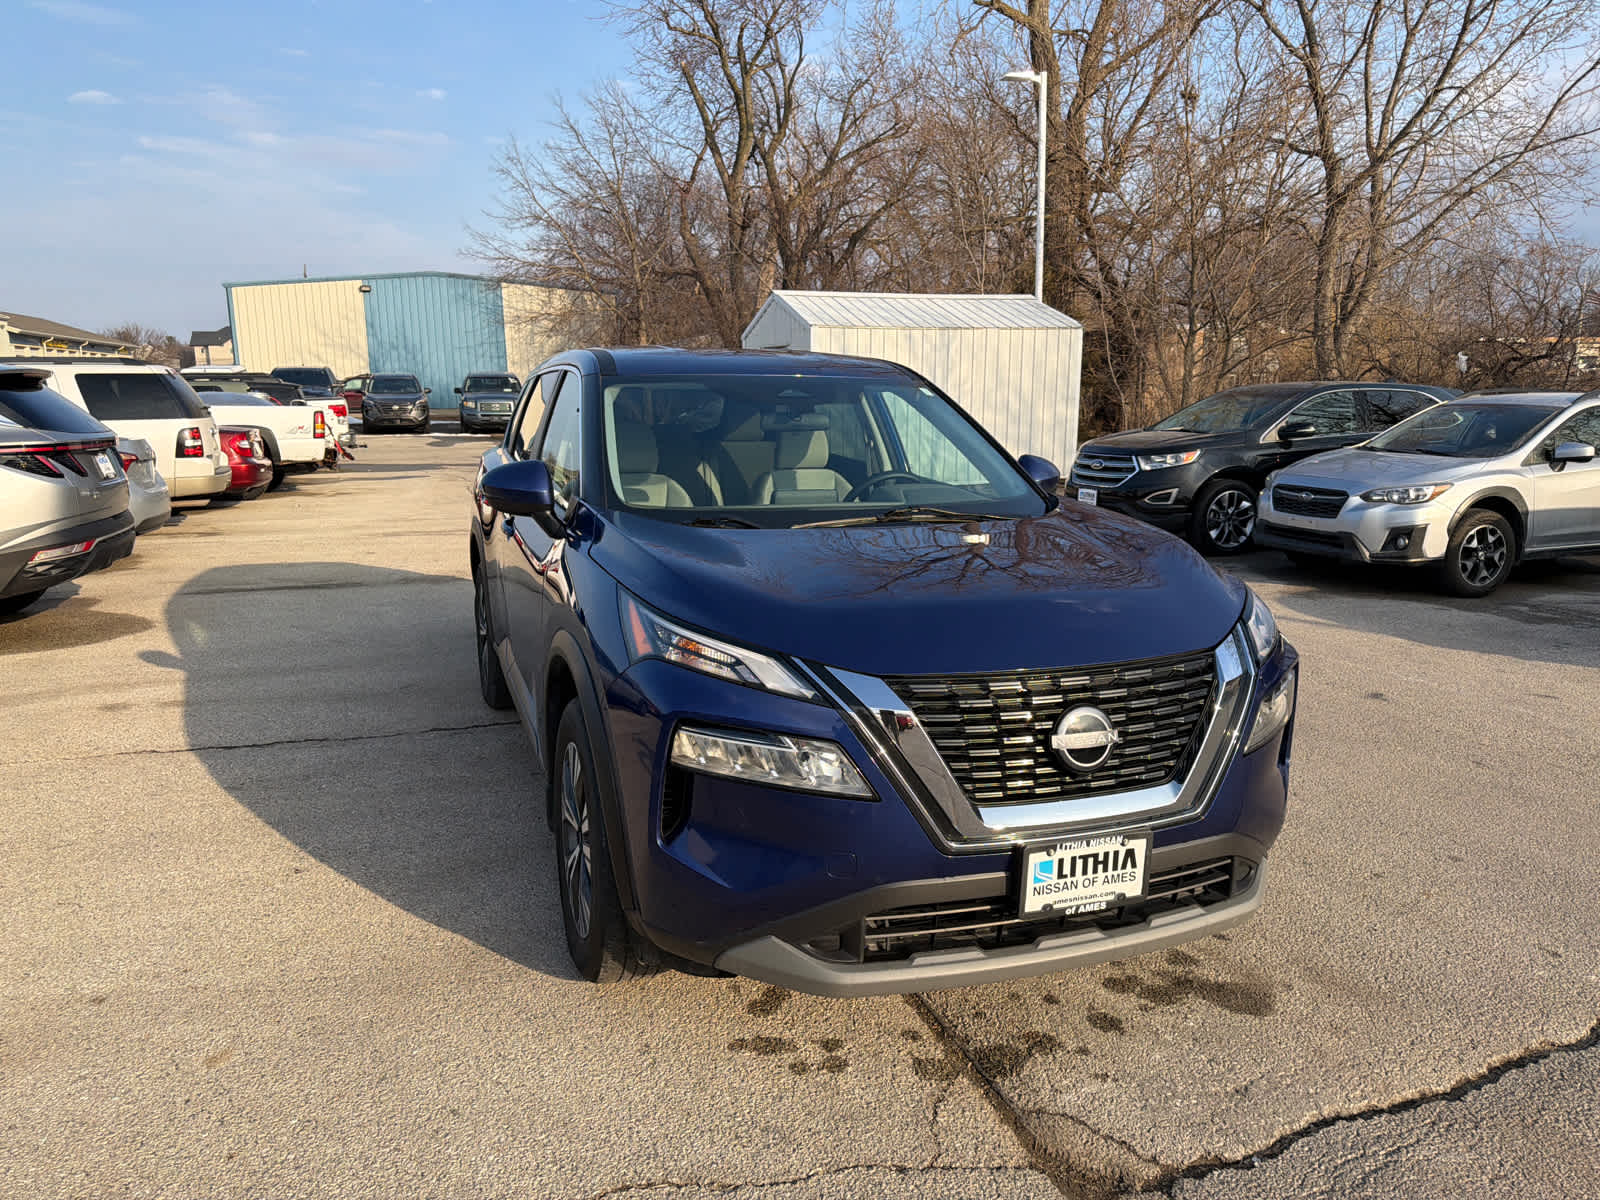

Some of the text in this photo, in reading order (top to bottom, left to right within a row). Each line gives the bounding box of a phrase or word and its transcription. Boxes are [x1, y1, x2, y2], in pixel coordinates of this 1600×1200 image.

[1056, 835, 1124, 852] LITHIA NISSAN
[1056, 847, 1138, 880] LITHIA
[1032, 871, 1137, 897] NISSAN OF AMES
[1052, 890, 1117, 905] amesnissan.com
[1077, 902, 1107, 914] AMES
